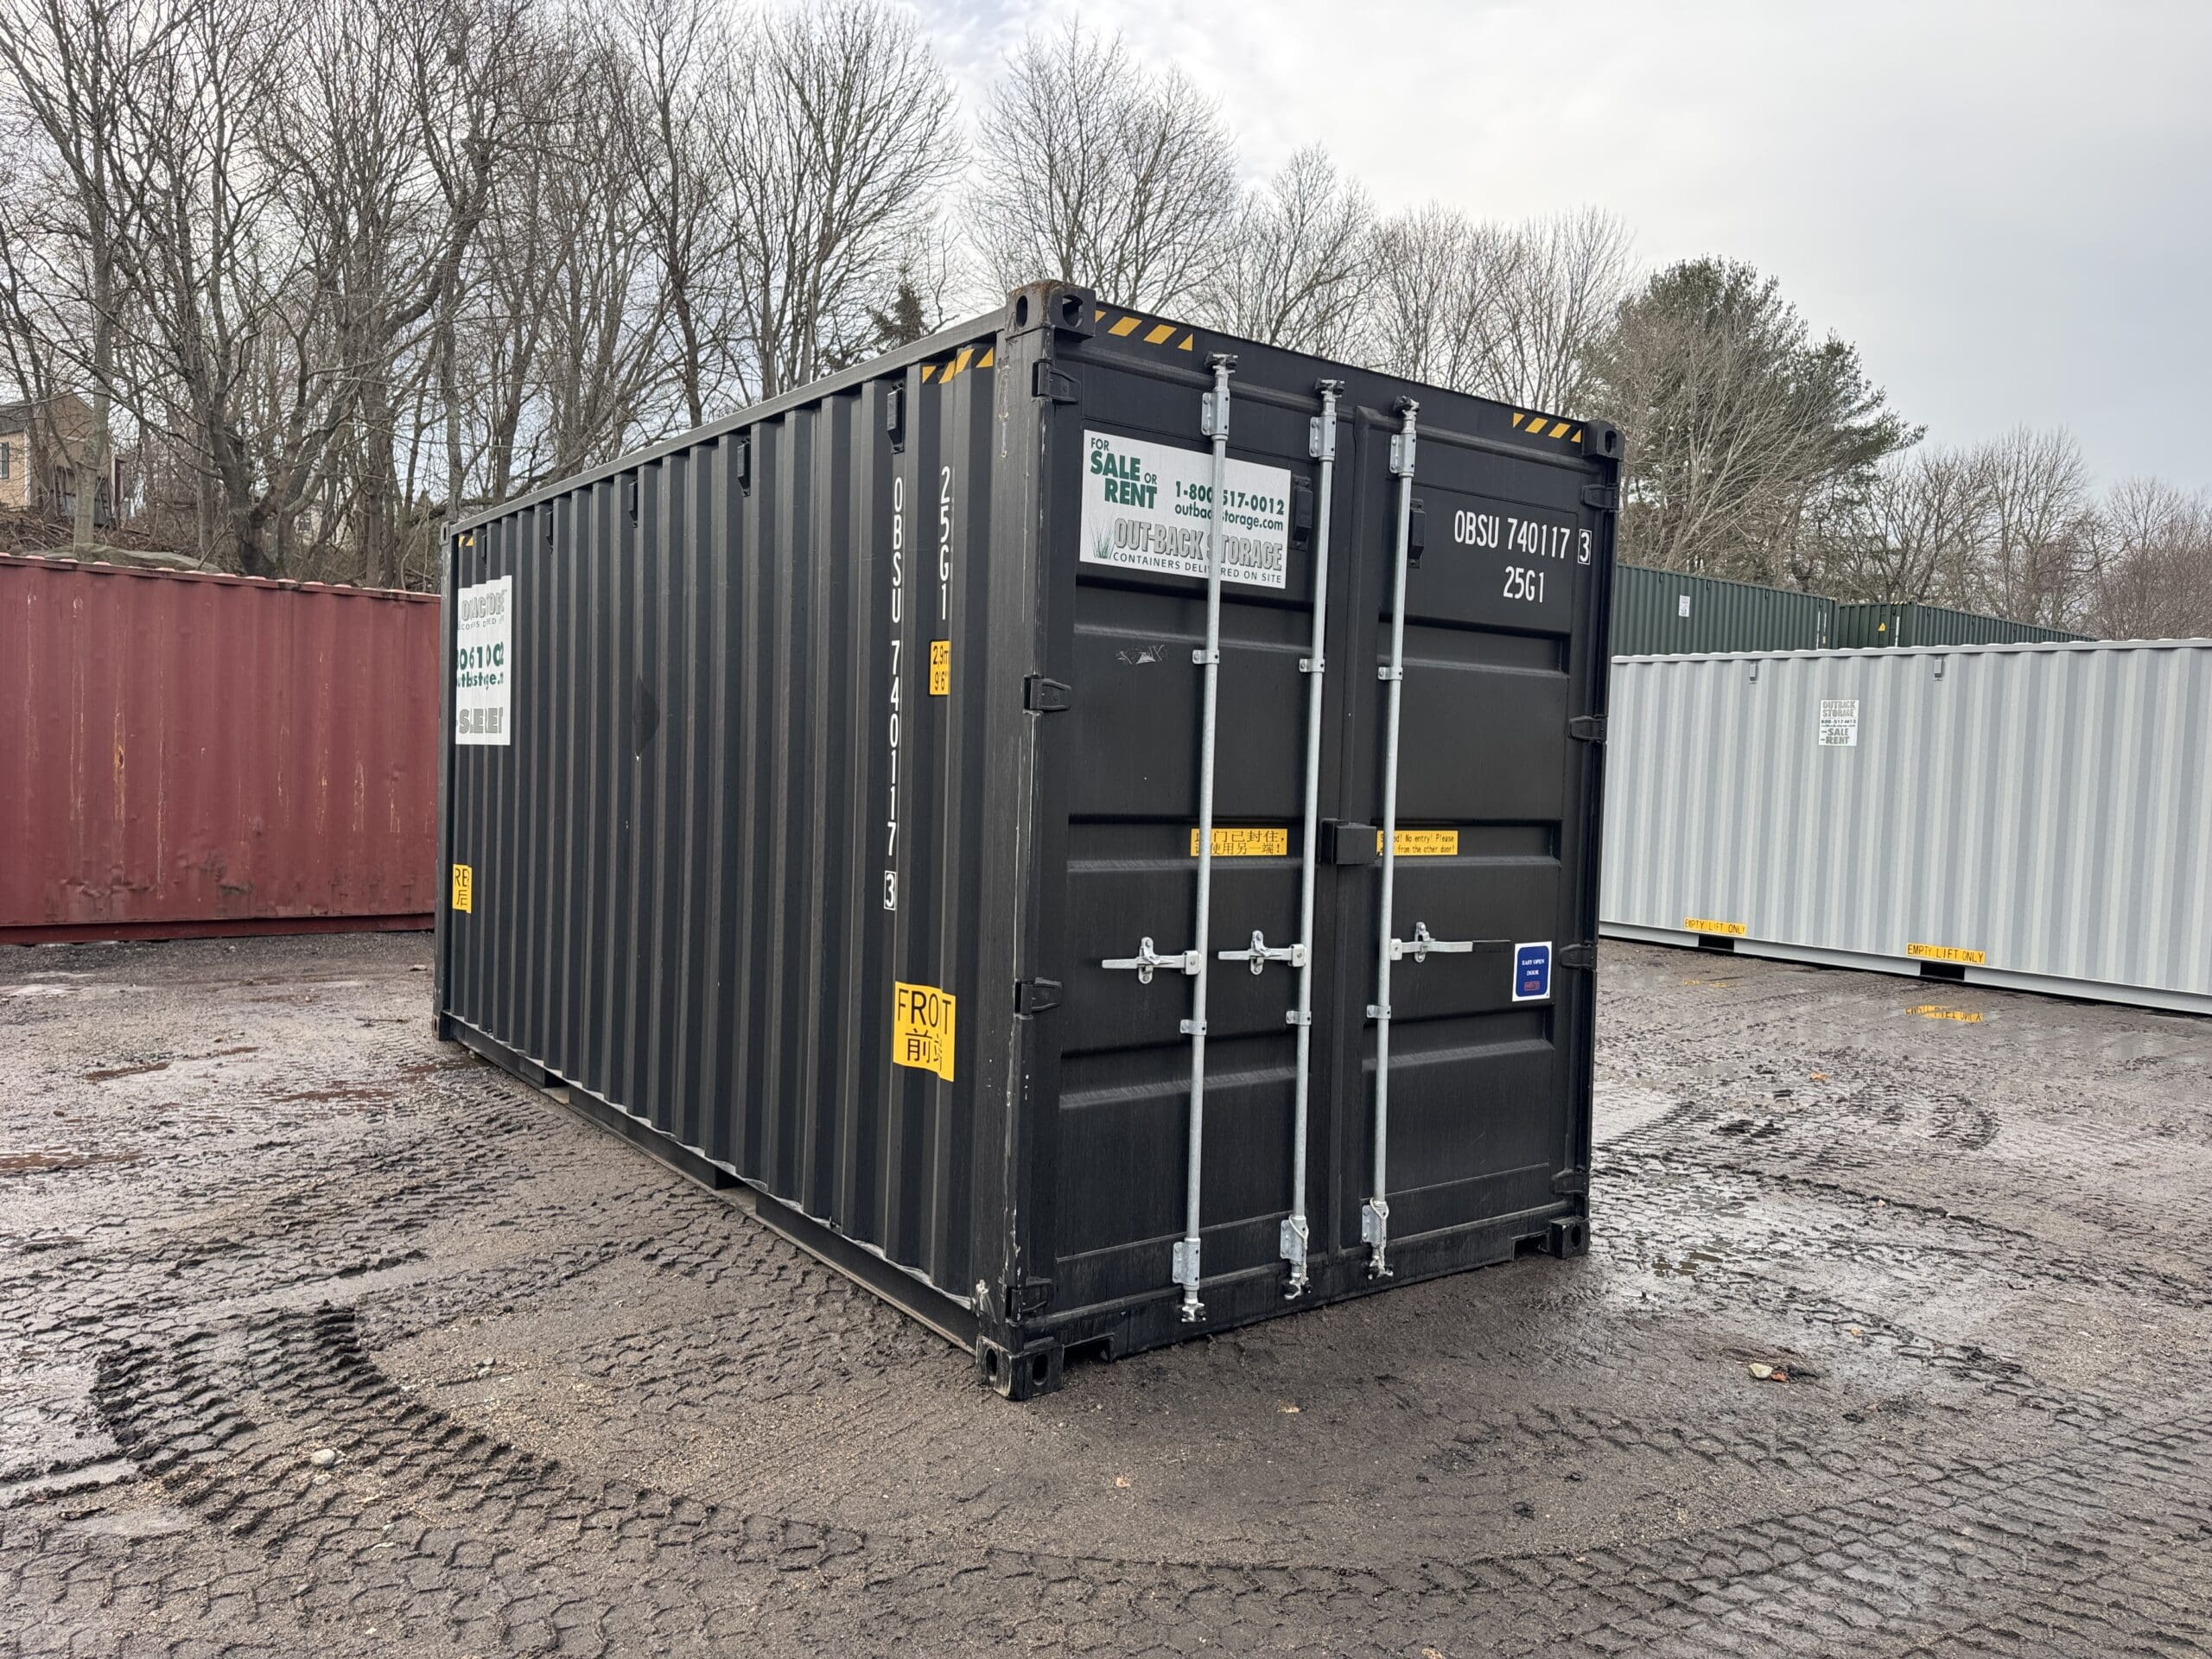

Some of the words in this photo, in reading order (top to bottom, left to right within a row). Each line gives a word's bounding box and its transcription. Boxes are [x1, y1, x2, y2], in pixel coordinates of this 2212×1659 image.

[1090, 437, 1109, 452] FOR
[1090, 449, 1141, 482] SALE
[1144, 473, 1158, 486] OR
[1104, 477, 1158, 510] RENT
[1175, 480, 1285, 516] 1-800517-0012
[892, 477, 903, 624] OBSU
[939, 466, 951, 620] 25G1
[1454, 510, 1500, 549] OBSU
[1507, 518, 1571, 559] 740117
[1580, 531, 1590, 563] 3
[1113, 551, 1180, 569] CONTAINERS
[1185, 562, 1240, 578] DELIRED
[1244, 570, 1257, 581] ON
[1262, 573, 1281, 583] SITE
[1503, 566, 1545, 603] 25G1
[887, 639, 901, 856] 740117
[1435, 834, 1454, 842] Please
[885, 873, 895, 908] 3
[1708, 922, 1723, 931] LIFT
[1728, 924, 1745, 935] ONLY
[1907, 944, 1932, 956] EMPTY
[1936, 948, 1958, 959] LIFT
[1962, 951, 1984, 963] ONLY
[898, 988, 952, 1035] FROT
